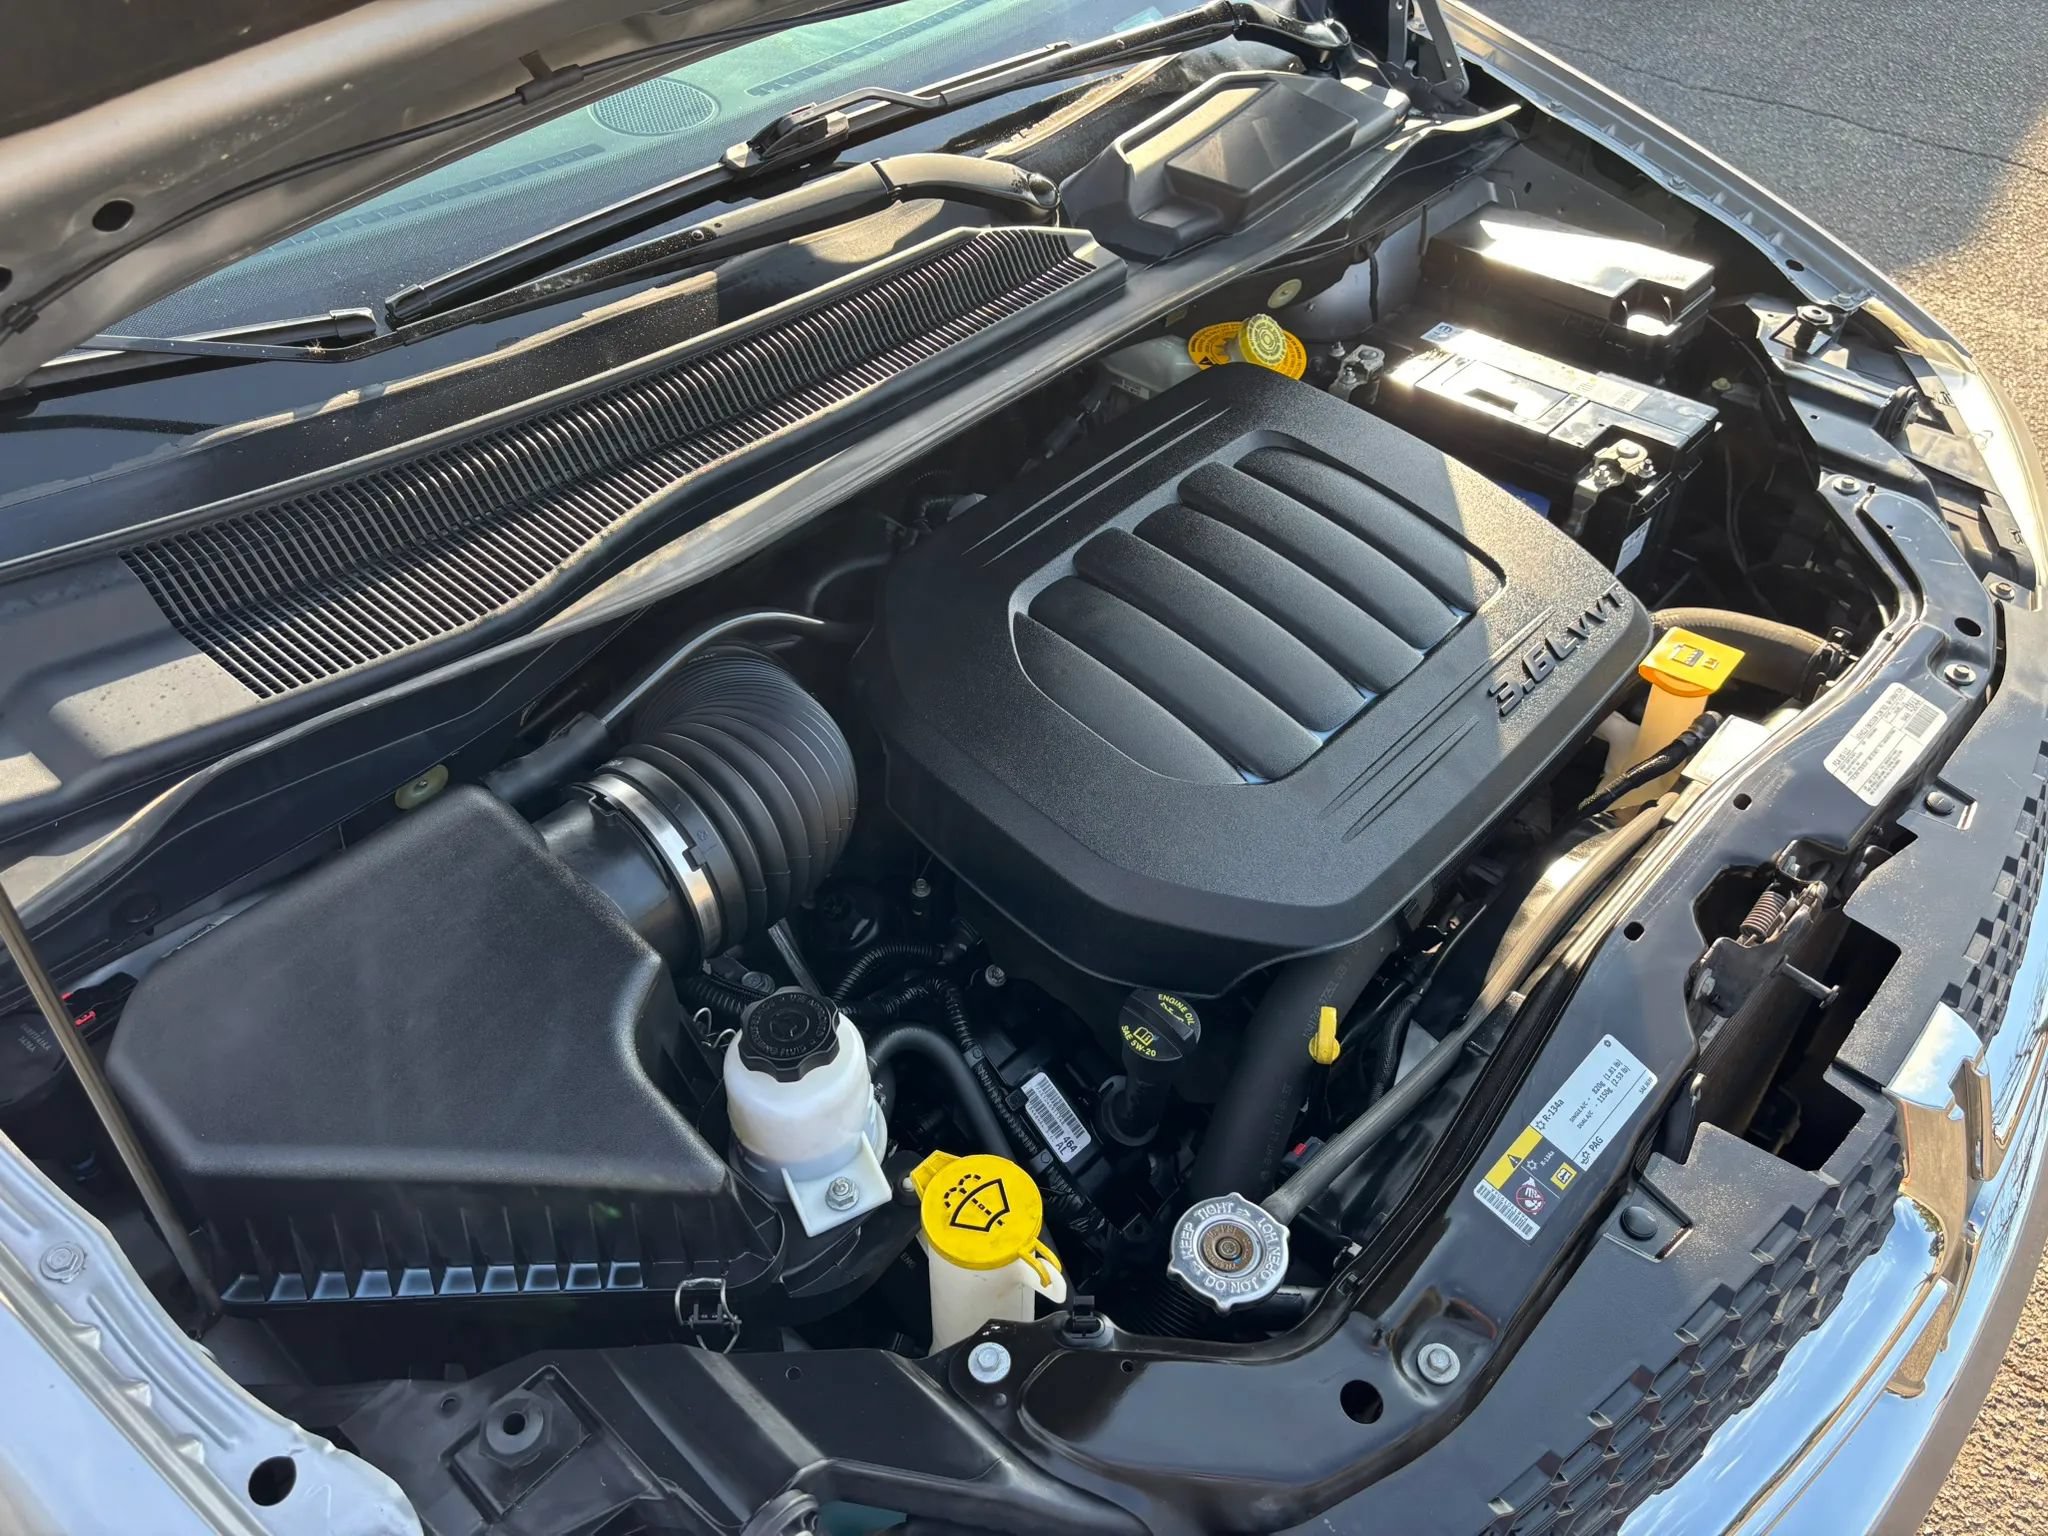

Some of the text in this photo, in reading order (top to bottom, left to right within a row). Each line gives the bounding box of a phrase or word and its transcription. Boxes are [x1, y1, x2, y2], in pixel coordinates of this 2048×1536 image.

[1158, 993, 1196, 1026] ENGINE OIL
[1121, 1024, 1157, 1057] SAE 5W-20
[1569, 1108, 1583, 1123] SINGLE
[1591, 1080, 1606, 1095] 820g
[1603, 1066, 1617, 1081] (1.81
[1613, 1058, 1623, 1069] lb)
[1577, 1116, 1589, 1129] DUAL
[1597, 1086, 1613, 1104] 1150g
[1610, 1071, 1625, 1087] (2.53
[1620, 1064, 1631, 1075] lb)
[1542, 1098, 1565, 1122] R-134a
[1056, 1142, 1067, 1156] AL
[1063, 1135, 1078, 1153] 464
[1588, 1136, 1604, 1152] PAG
[1540, 1150, 1555, 1166] R-134a
[1179, 1222, 1195, 1260] KEEP
[1194, 1201, 1234, 1221] TIGHT
[1257, 1217, 1279, 1243] HOT
[1260, 1246, 1282, 1281] OPEN
[1205, 1275, 1227, 1292] DO
[1230, 1277, 1260, 1294] NOT
